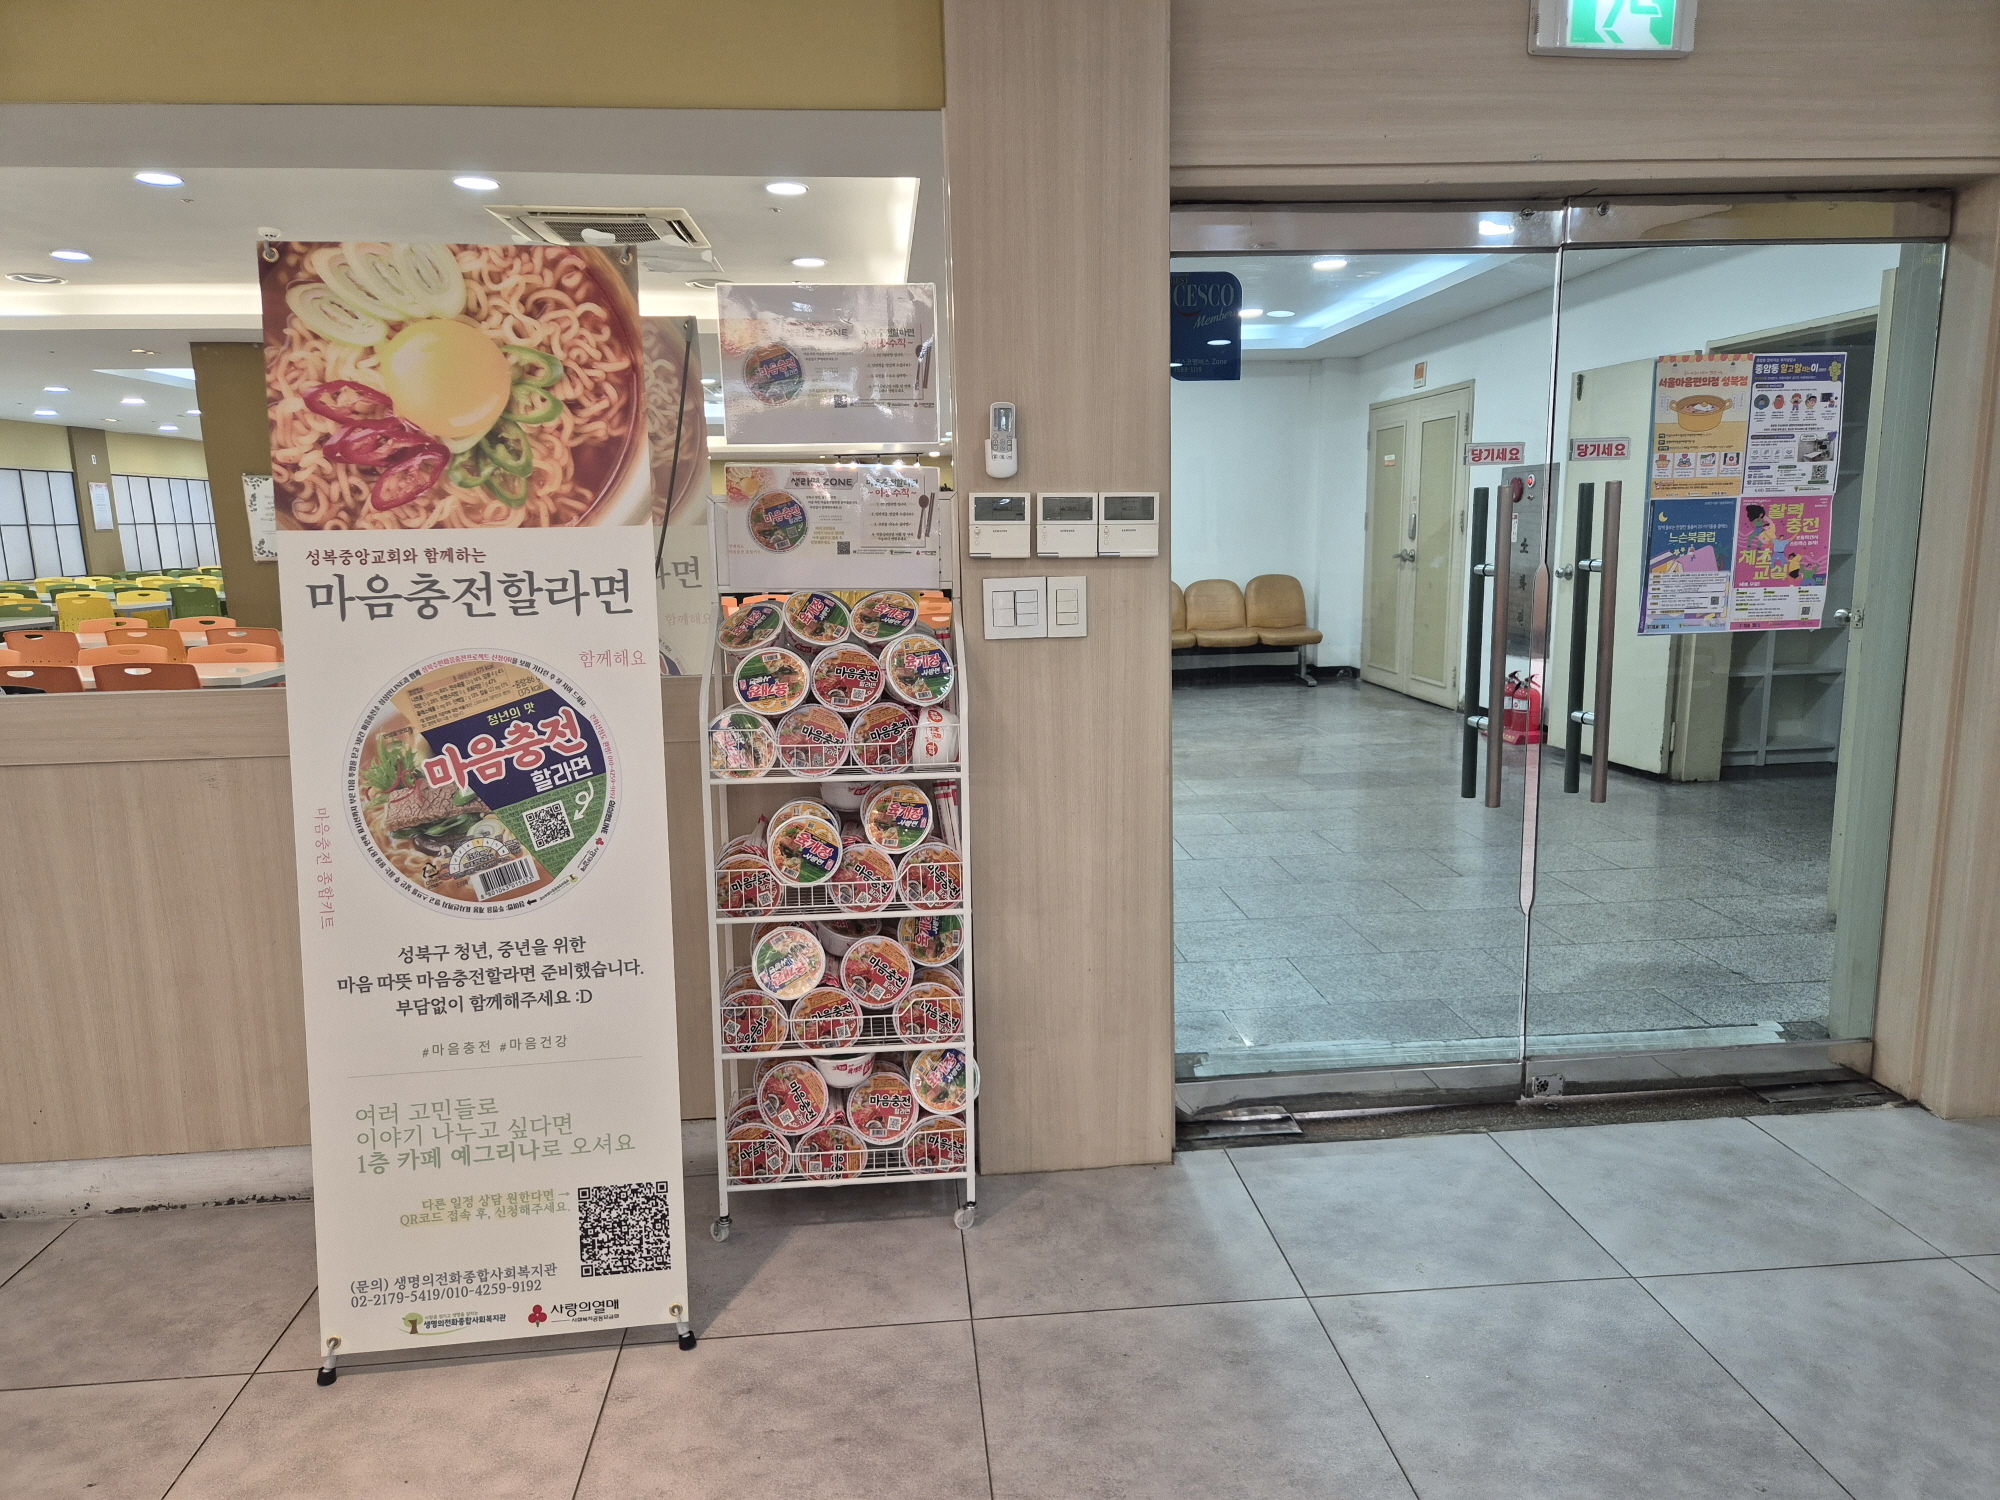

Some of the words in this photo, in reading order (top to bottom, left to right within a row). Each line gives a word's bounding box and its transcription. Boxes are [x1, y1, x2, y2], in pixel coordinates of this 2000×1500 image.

[1173, 283, 1235, 307] CESCO
[1193, 307, 1236, 330] Members
[817, 328, 848, 337] ZONE
[759, 356, 797, 378] 마음충전
[1211, 357, 1228, 365] Zone
[1755, 363, 1780, 374] 종암동
[1659, 376, 1720, 388] 서울마음편의점
[1721, 375, 1748, 387] 성북점
[1470, 447, 1521, 462] 당기세요
[1576, 443, 1626, 458] 당기세요
[823, 477, 853, 487] ZONE
[893, 488, 910, 498] 수칙
[764, 505, 802, 524] 마음충전
[1768, 502, 1805, 519] 활력
[1786, 517, 1820, 533] 충전
[1668, 531, 1716, 544] 느슨북클럽
[305, 548, 418, 566] 성복중앙교회와
[423, 547, 487, 565] 함께하는
[1752, 564, 1789, 580] 교실
[306, 568, 634, 622] 마음충전할라면
[798, 597, 825, 626] 육개장
[873, 603, 910, 621] 육개장
[578, 648, 647, 668] 함께해요
[904, 654, 941, 670] 육개장
[835, 666, 880, 682] 마음충전
[747, 682, 789, 699] 육개장
[486, 707, 522, 726] 청년의
[523, 701, 536, 715] 맛
[870, 718, 911, 741] 마음충전
[423, 707, 587, 790] 마음충전
[530, 760, 594, 793] 할라면
[885, 801, 924, 821] 육개장
[313, 807, 333, 866] 마음충전
[793, 831, 835, 860] 육개장
[316, 871, 336, 930] 종합키트
[398, 944, 451, 965] 성북구
[453, 941, 494, 961] 청년,
[497, 938, 549, 959] 중년을
[552, 935, 587, 955] 위한
[337, 974, 374, 995] 마음
[376, 971, 413, 992] 따뜻
[416, 964, 537, 990] 마음충전할라면
[540, 958, 645, 982] 준비했습니다.
[868, 955, 907, 989] 마음충전
[395, 994, 465, 1018] 부담없이
[468, 989, 572, 1013] 함께해주세요
[574, 989, 593, 1005] :D
[422, 1039, 492, 1059] #마음충전
[499, 1034, 568, 1053] #마음건강
[355, 1102, 399, 1127] 여러
[407, 1097, 500, 1122] 고민들로
[789, 1080, 818, 1122] 마음충전
[869, 1094, 912, 1108] 마음충전
[356, 1123, 423, 1151] 이야기
[431, 1121, 500, 1145] 나누고
[507, 1112, 574, 1140] 싶다면
[357, 1149, 390, 1175] 1층
[397, 1146, 442, 1171] 카페
[450, 1138, 563, 1168] 예그리나로
[570, 1132, 636, 1156] 오셔요
[421, 1198, 447, 1212] 다른
[449, 1195, 474, 1209] 일정
[477, 1192, 502, 1207] 상담
[506, 1188, 555, 1205] 원한다면
[400, 1211, 444, 1227] QR코드
[447, 1208, 472, 1223] 접속
[474, 1206, 492, 1221] 후,
[494, 1200, 572, 1219] 신청해주세요.
[350, 1277, 389, 1295] (문의)
[393, 1262, 558, 1291] 생명의전화종합사회복지관
[351, 1279, 543, 1309] 02-2179-5419/010-4259-9192
[550, 1298, 620, 1318] 사랑의열매
[423, 1313, 507, 1330] 생명의전화종합사회복지관
